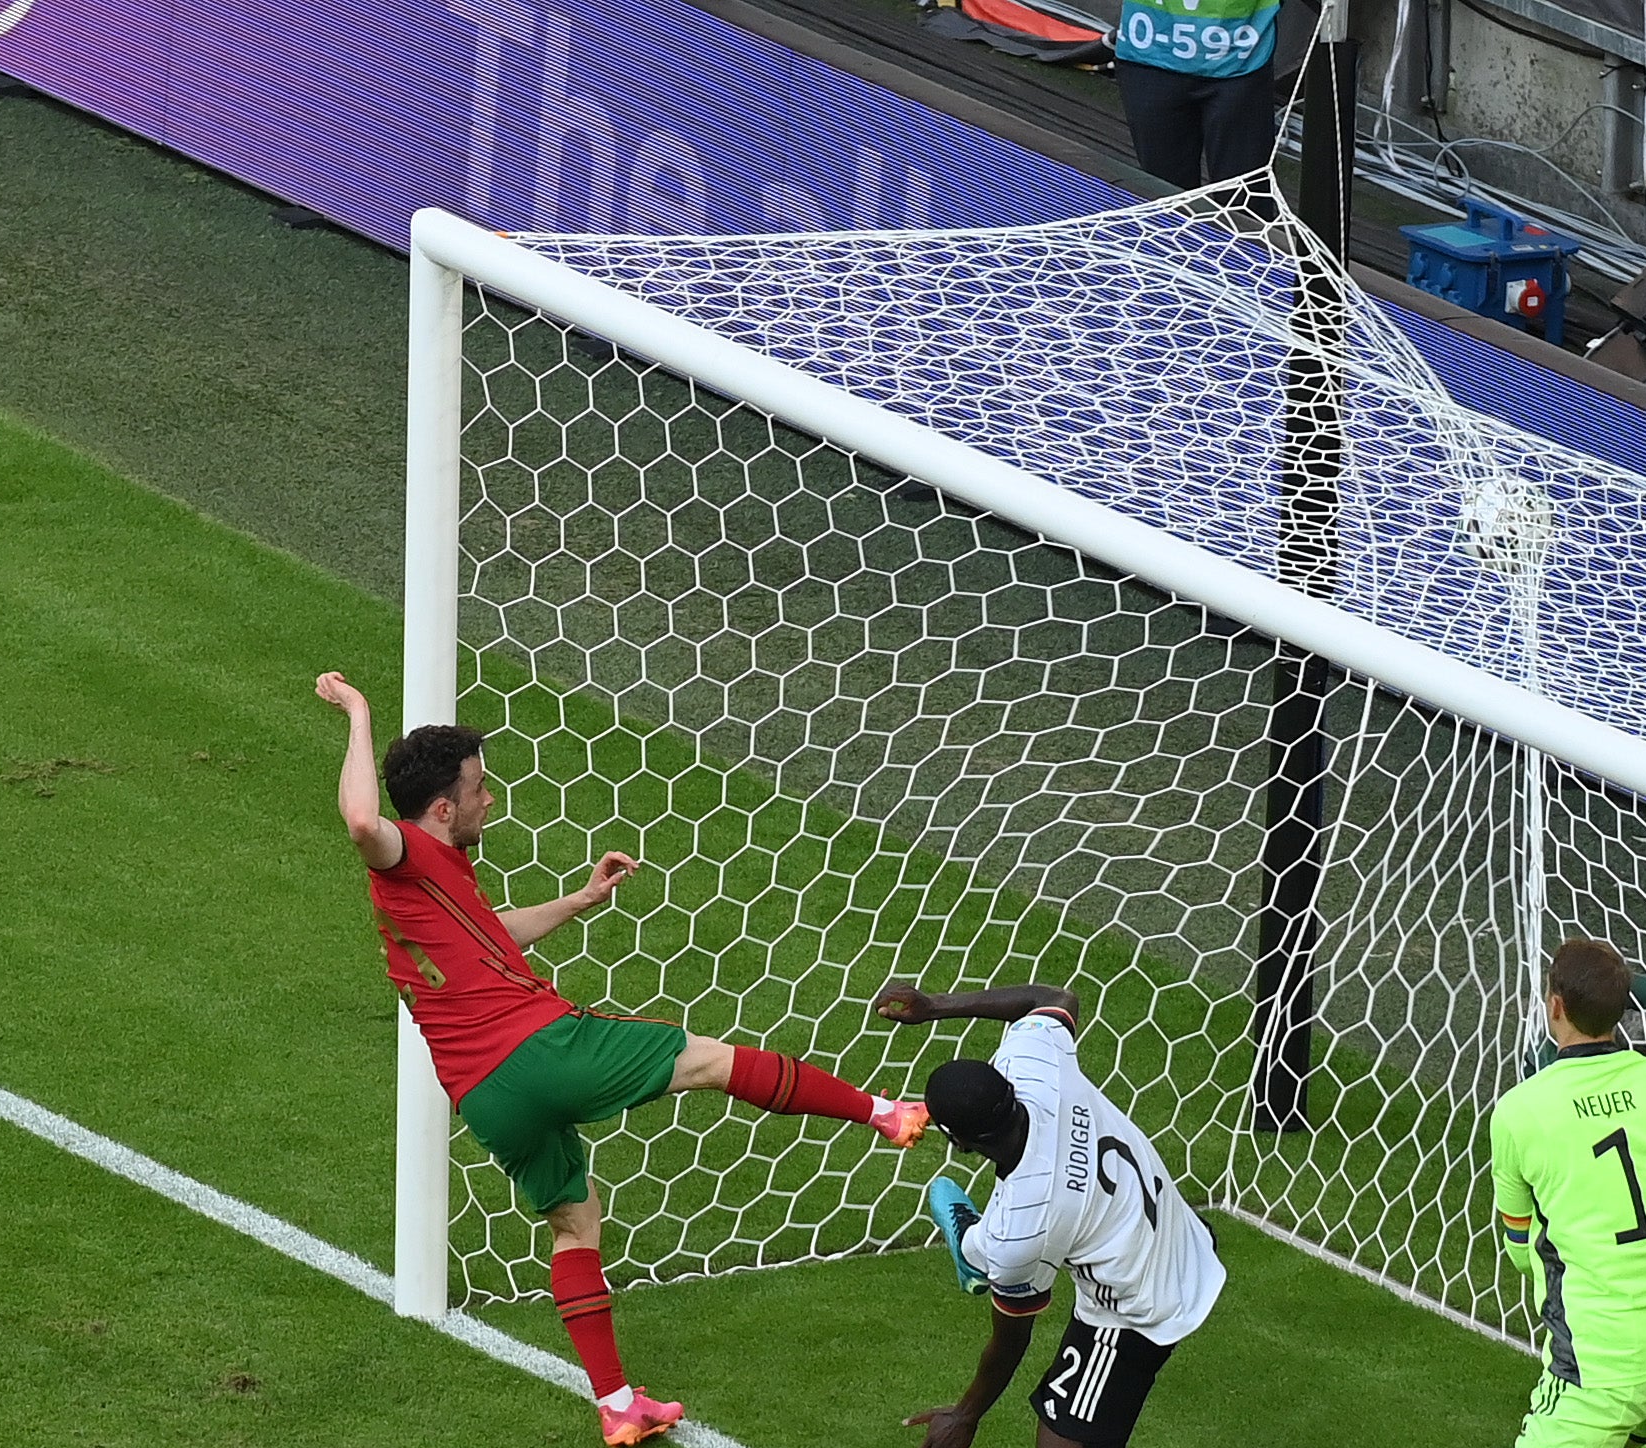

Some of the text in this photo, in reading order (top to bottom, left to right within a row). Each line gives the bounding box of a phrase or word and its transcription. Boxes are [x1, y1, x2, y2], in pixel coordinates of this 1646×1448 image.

[1116, 12, 1260, 60] 0-599
[1572, 1090, 1637, 1119] NEUER
[1065, 1105, 1091, 1193] RÜDIGER
[1097, 1136, 1163, 1232] 2
[1048, 1345, 1081, 1399] 2
